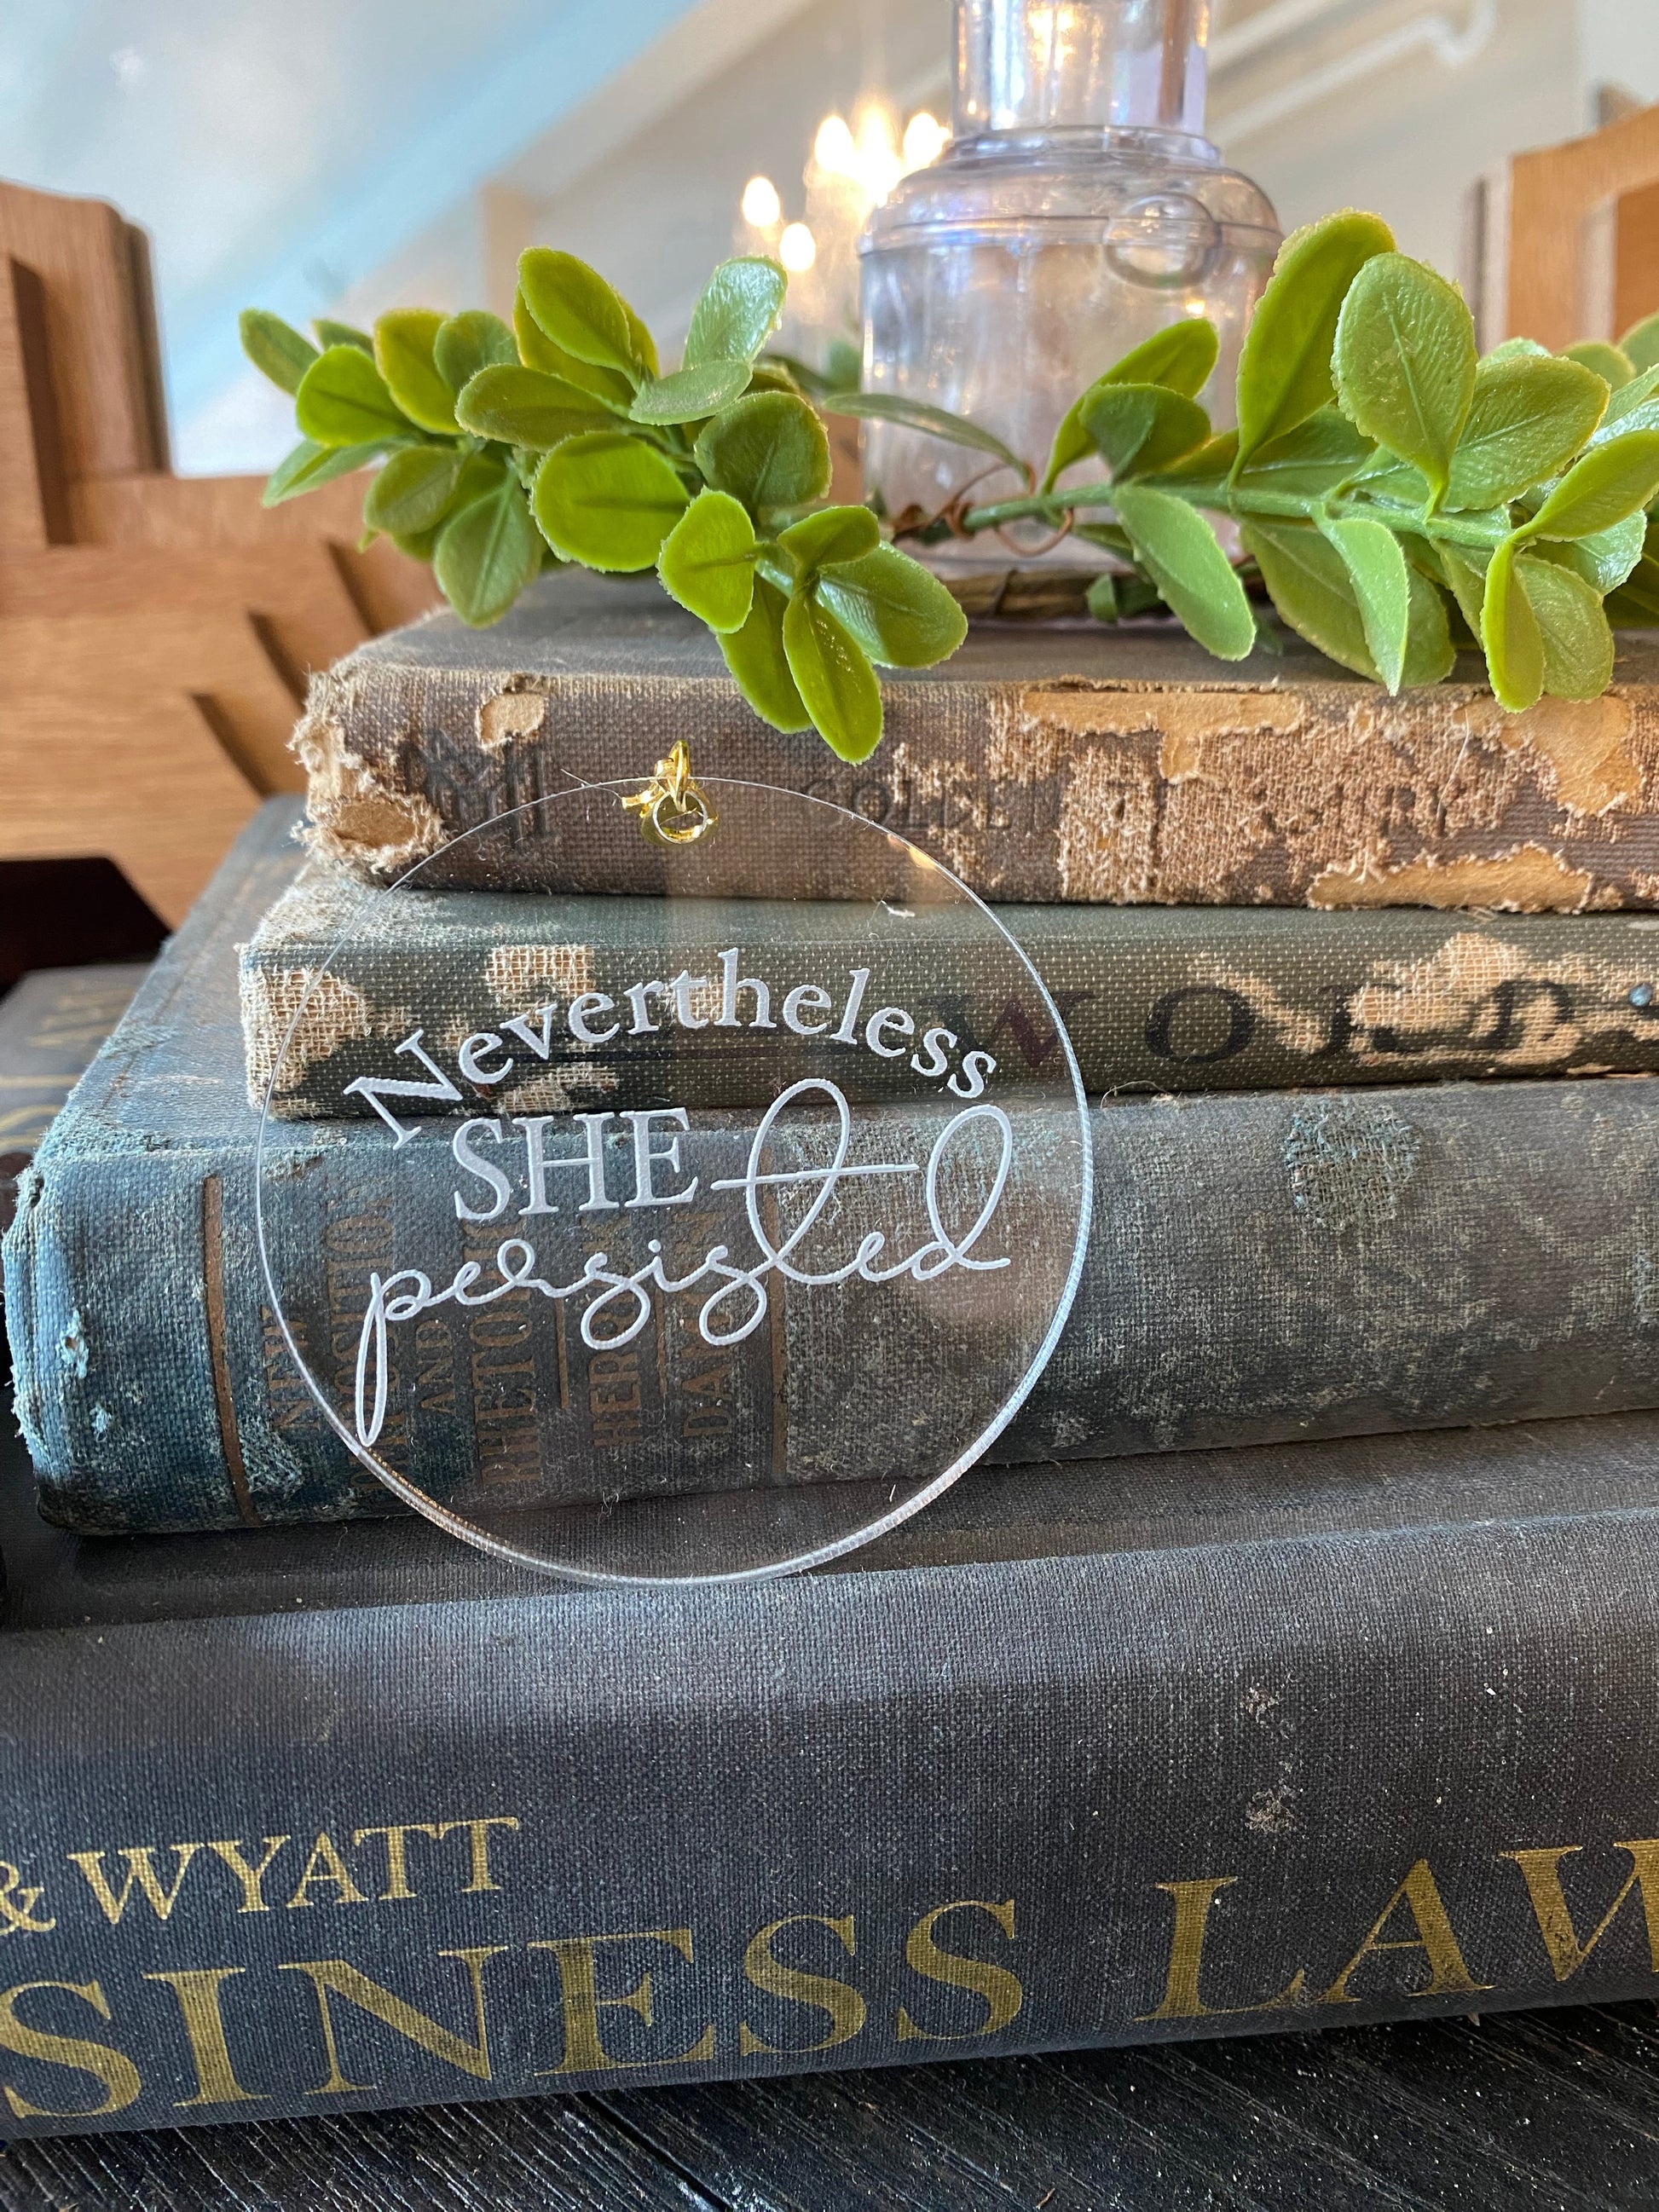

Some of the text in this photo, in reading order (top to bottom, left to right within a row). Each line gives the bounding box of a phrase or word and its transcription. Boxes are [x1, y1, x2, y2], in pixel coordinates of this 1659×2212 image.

[344, 947, 997, 1150] Nevertheless
[453, 1106, 698, 1221] SHE
[355, 1077, 1011, 1447] persisted
[415, 1320, 458, 1412] AND
[0, 1816, 518, 1933] & WYATT
[0, 1836, 1659, 2119] SINESS LAW
